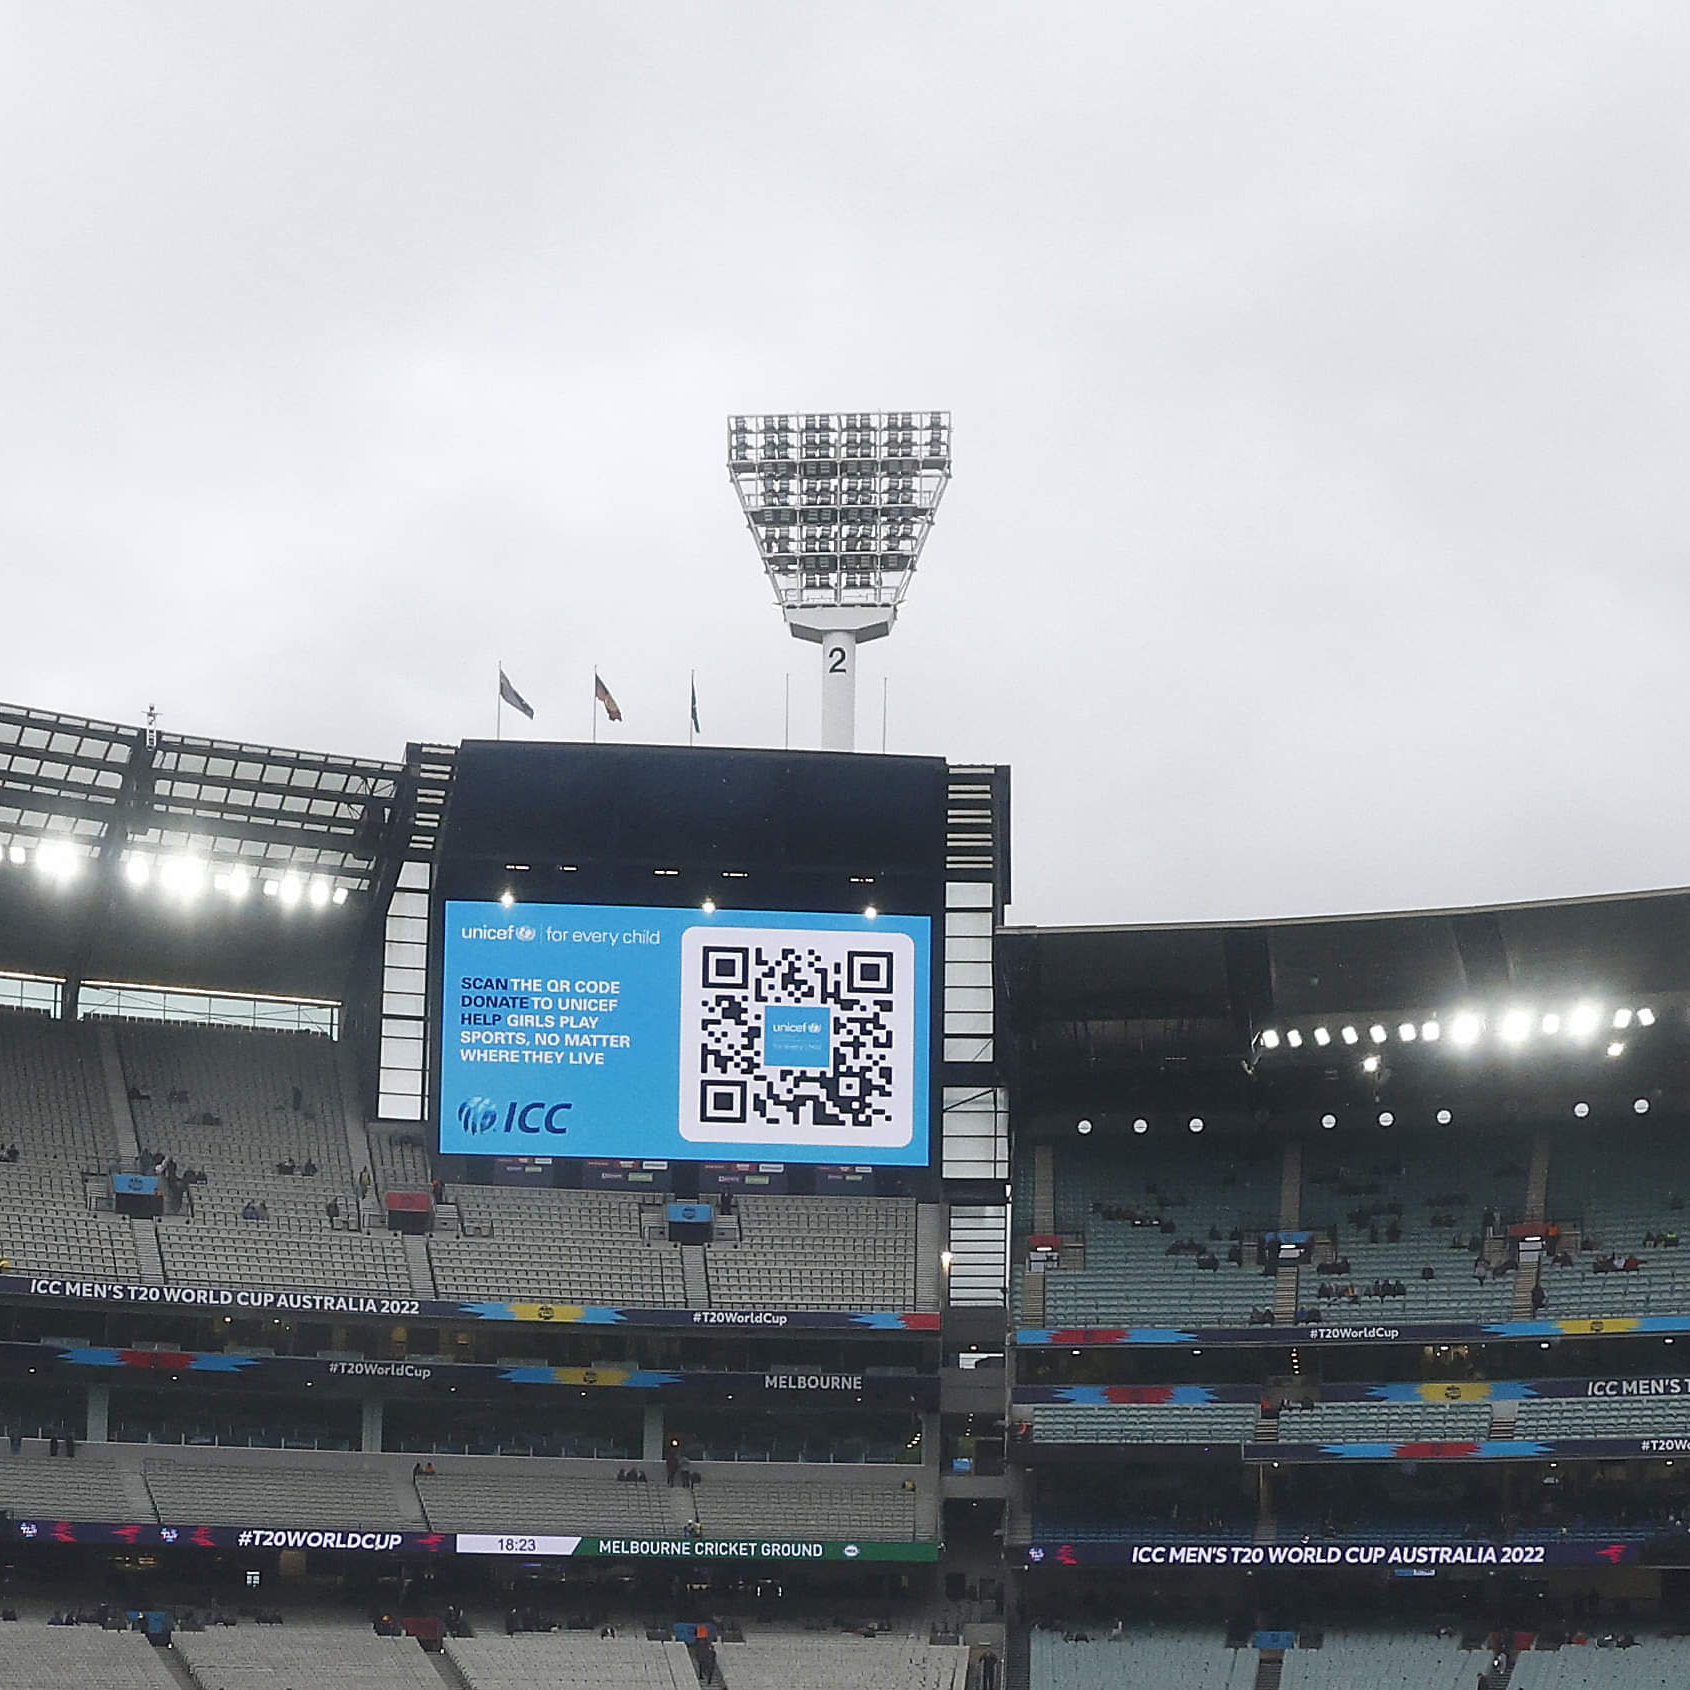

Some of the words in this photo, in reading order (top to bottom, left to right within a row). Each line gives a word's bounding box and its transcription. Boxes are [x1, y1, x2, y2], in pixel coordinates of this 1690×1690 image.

[829, 647, 846, 673] 2
[462, 924, 514, 940] unicef
[547, 927, 568, 941] for
[573, 930, 619, 946] every
[623, 929, 660, 945] child
[461, 977, 508, 990] SCAN
[510, 978, 542, 992] THE
[547, 980, 570, 993] QR
[575, 981, 620, 994] CODE
[461, 996, 529, 1009] DONATE
[531, 997, 553, 1010] TO
[558, 999, 618, 1012] UNICEF
[461, 1013, 501, 1025] HELP
[507, 1015, 555, 1027] GIRLS
[559, 1016, 599, 1029] PLAY
[461, 1031, 531, 1046] SPORTS,
[535, 1033, 560, 1045] NO
[565, 1034, 630, 1048] MATTER
[460, 1049, 519, 1062] WHERE
[522, 1051, 565, 1063] THEY
[569, 1052, 604, 1065] LIVE
[504, 1102, 572, 1135] ICC
[30, 1279, 61, 1296] ICC
[65, 1281, 123, 1299] MEN'S
[126, 1285, 160, 1301] T20
[163, 1287, 232, 1305] WORLD
[236, 1291, 275, 1307] CUP
[276, 1294, 377, 1312] AUSTRALIA
[380, 1299, 420, 1314] 2022
[692, 1311, 787, 1326] #T20WorldCup
[1309, 1327, 1399, 1339] #T20WorldCup
[328, 1361, 431, 1379] #T20WorldCup
[764, 1375, 862, 1389] MELBOURNE
[1587, 1380, 1618, 1396] ICC
[1622, 1378, 1681, 1394] MEN'S
[238, 1530, 401, 1550] #T20WORLDCUP
[497, 1538, 535, 1551] 18:23
[599, 1540, 690, 1555] MELBOURNE
[694, 1542, 757, 1555] CRICKET
[760, 1542, 823, 1556] GROUND
[1132, 1547, 1165, 1562] ICC
[1168, 1547, 1227, 1562] MEN'S
[1230, 1547, 1263, 1562] T20
[1267, 1546, 1341, 1562] WORLD
[1345, 1546, 1385, 1562] CUP
[1387, 1546, 1496, 1562] AUSTRALIA
[1500, 1546, 1545, 1562] 2022
